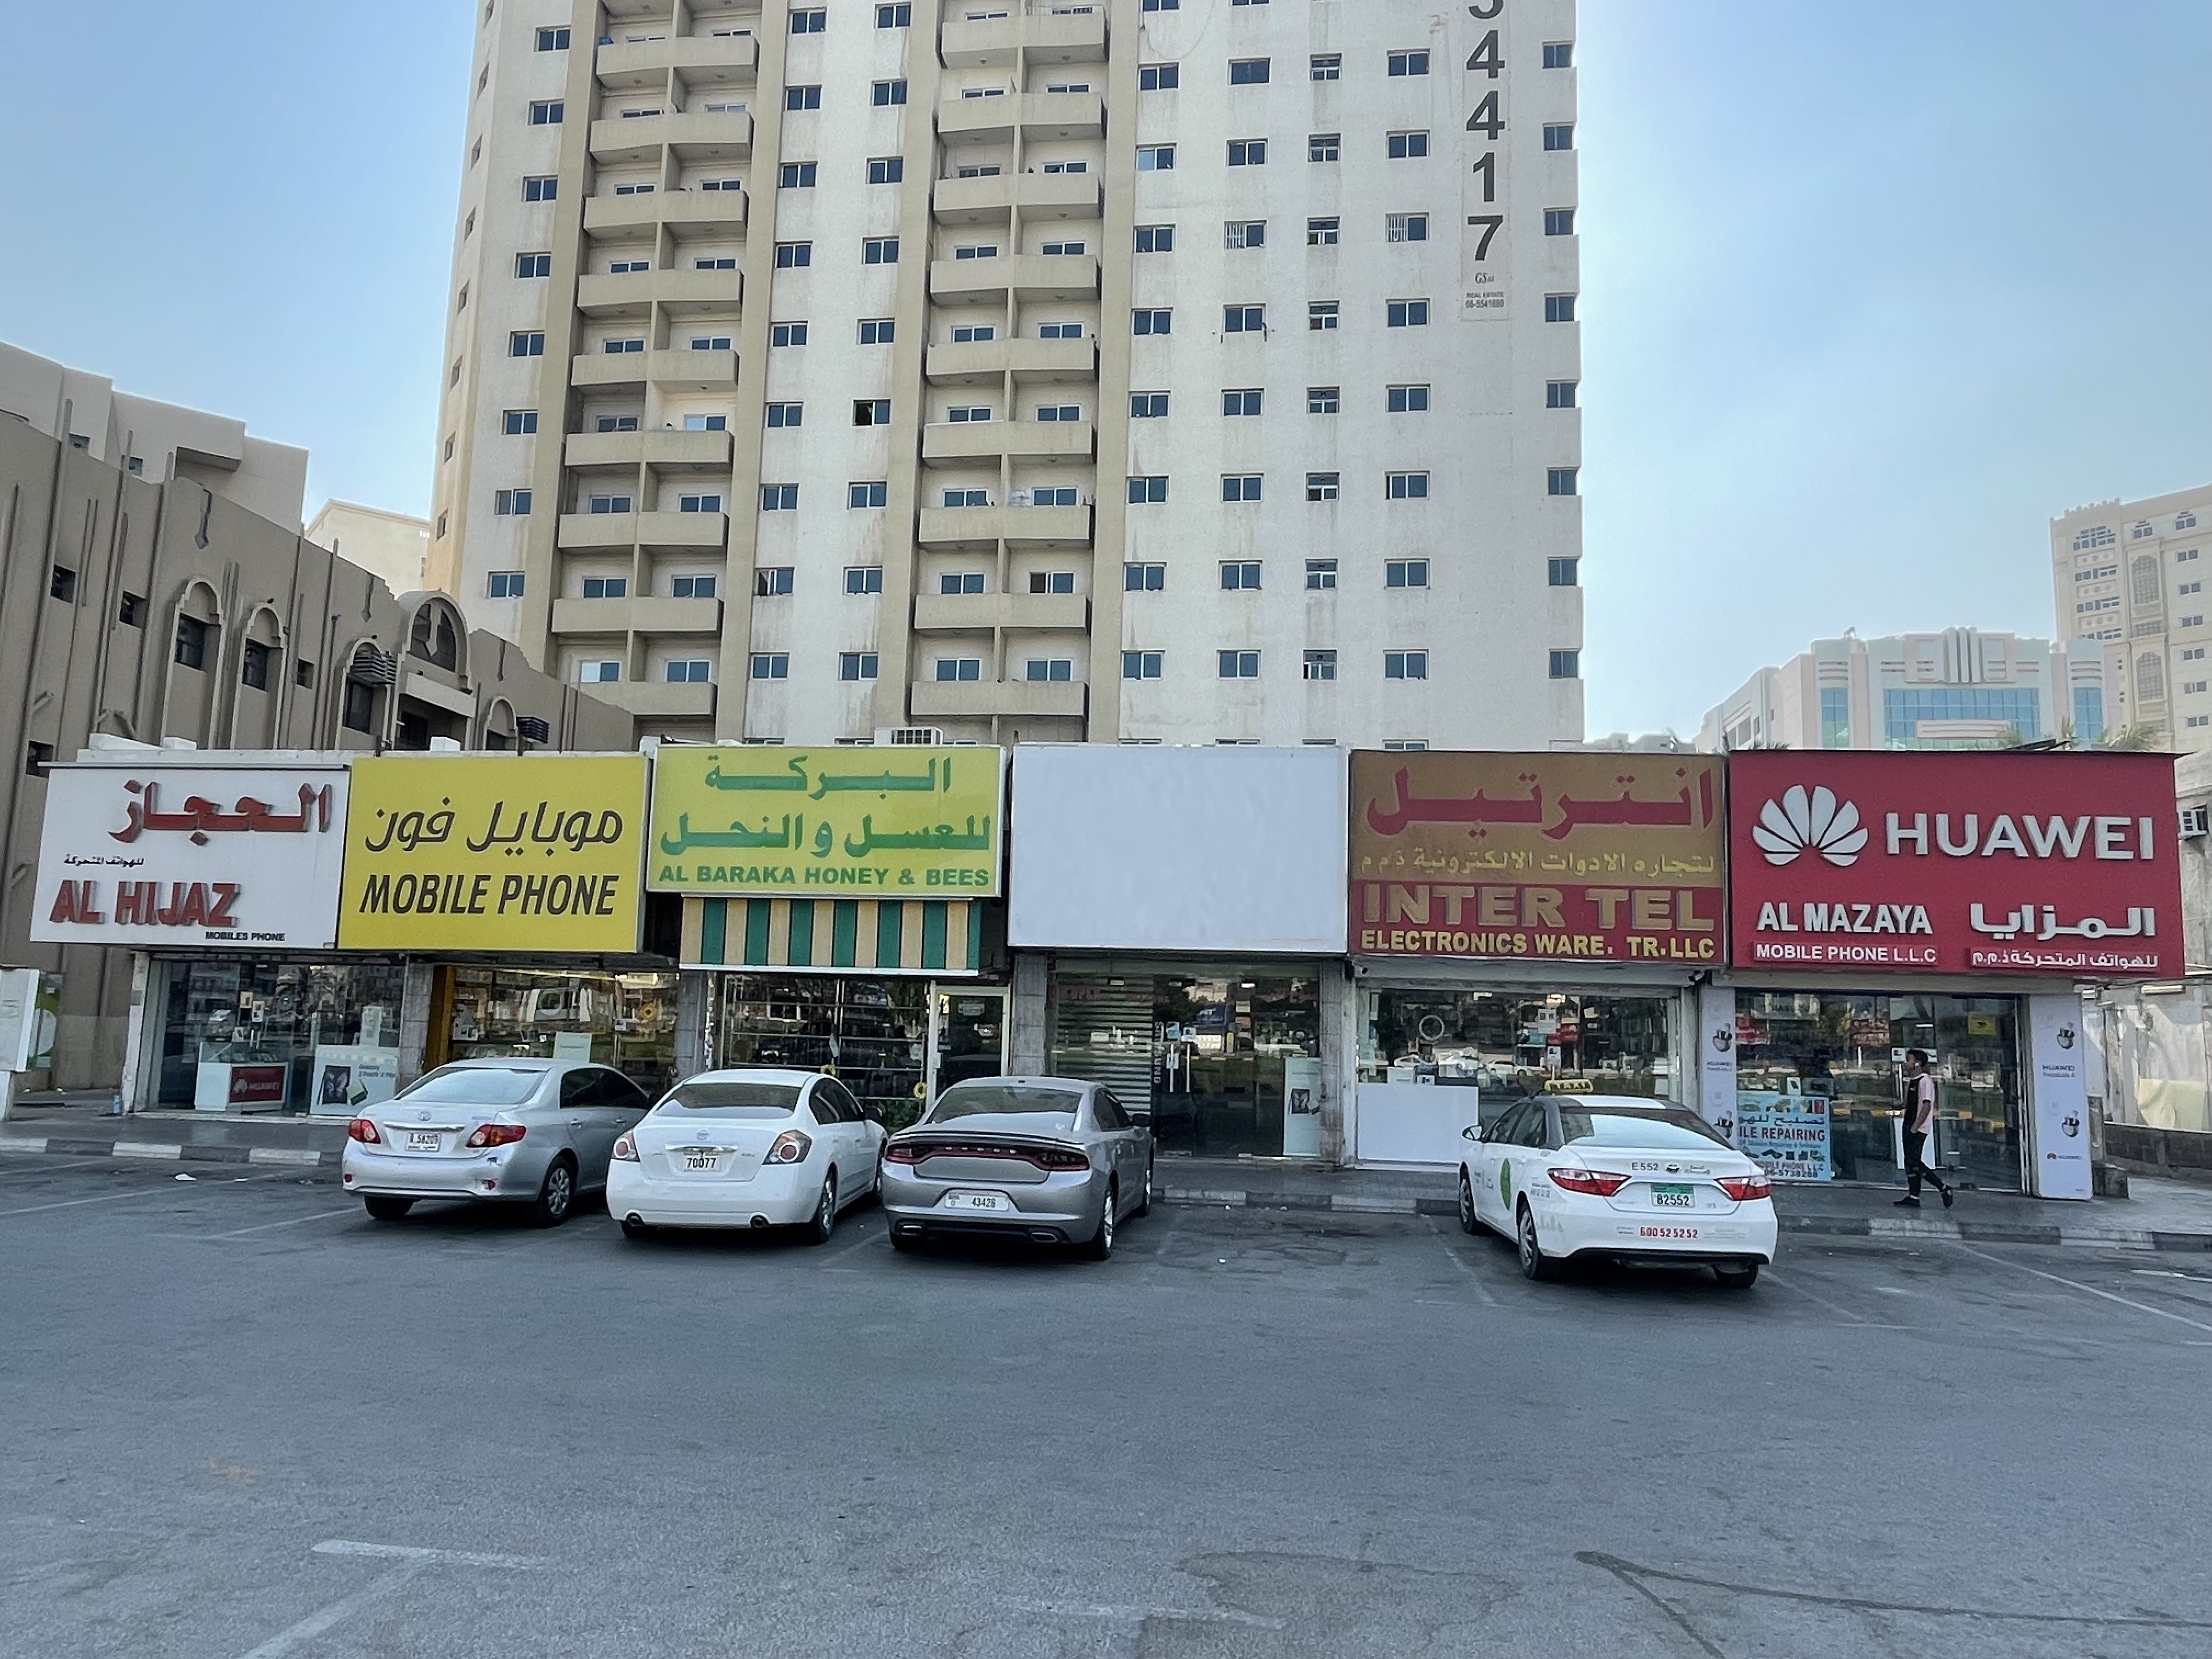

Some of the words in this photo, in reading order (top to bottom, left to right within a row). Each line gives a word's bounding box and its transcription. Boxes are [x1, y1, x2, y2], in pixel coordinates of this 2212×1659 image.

[704, 755, 951, 800] البركة
[108, 780, 332, 845] الحجاز
[365, 796, 455, 852] فون
[466, 800, 623, 856] موبايل
[844, 814, 991, 858] للعسل
[1886, 812, 2154, 860] HUAWEI
[659, 865, 689, 882] AL
[697, 865, 795, 884] BARAKA
[804, 867, 889, 885] HONEY
[898, 868, 916, 885] &
[926, 868, 989, 887] BEES
[1413, 846, 1533, 874] الالكترونية
[1540, 851, 1627, 877] الادوات
[49, 880, 105, 924] AL
[114, 880, 240, 928] HIJAZ
[359, 874, 492, 914] MOBILE
[497, 874, 620, 916] PHONE
[1363, 883, 1567, 928] INTER
[1585, 889, 1715, 932] TEL
[1756, 901, 1799, 931] AL
[1803, 902, 1934, 935] MAZAYA
[1971, 902, 2157, 941] المزايا
[205, 932, 248, 940] MOBILES
[251, 933, 285, 941] PHONE
[1361, 929, 1528, 954] ELECTRONICS
[1534, 933, 1614, 956] WARE.
[1756, 944, 1823, 960] MOBILE
[1827, 946, 1889, 961] PHONE
[1893, 947, 1937, 963] L.L.C
[2090, 952, 2159, 969] للهواتف
[1739, 1126, 1758, 1139] ILE
[1761, 1127, 1826, 1142] REPAIRING
[686, 1158, 716, 1169] 70077
